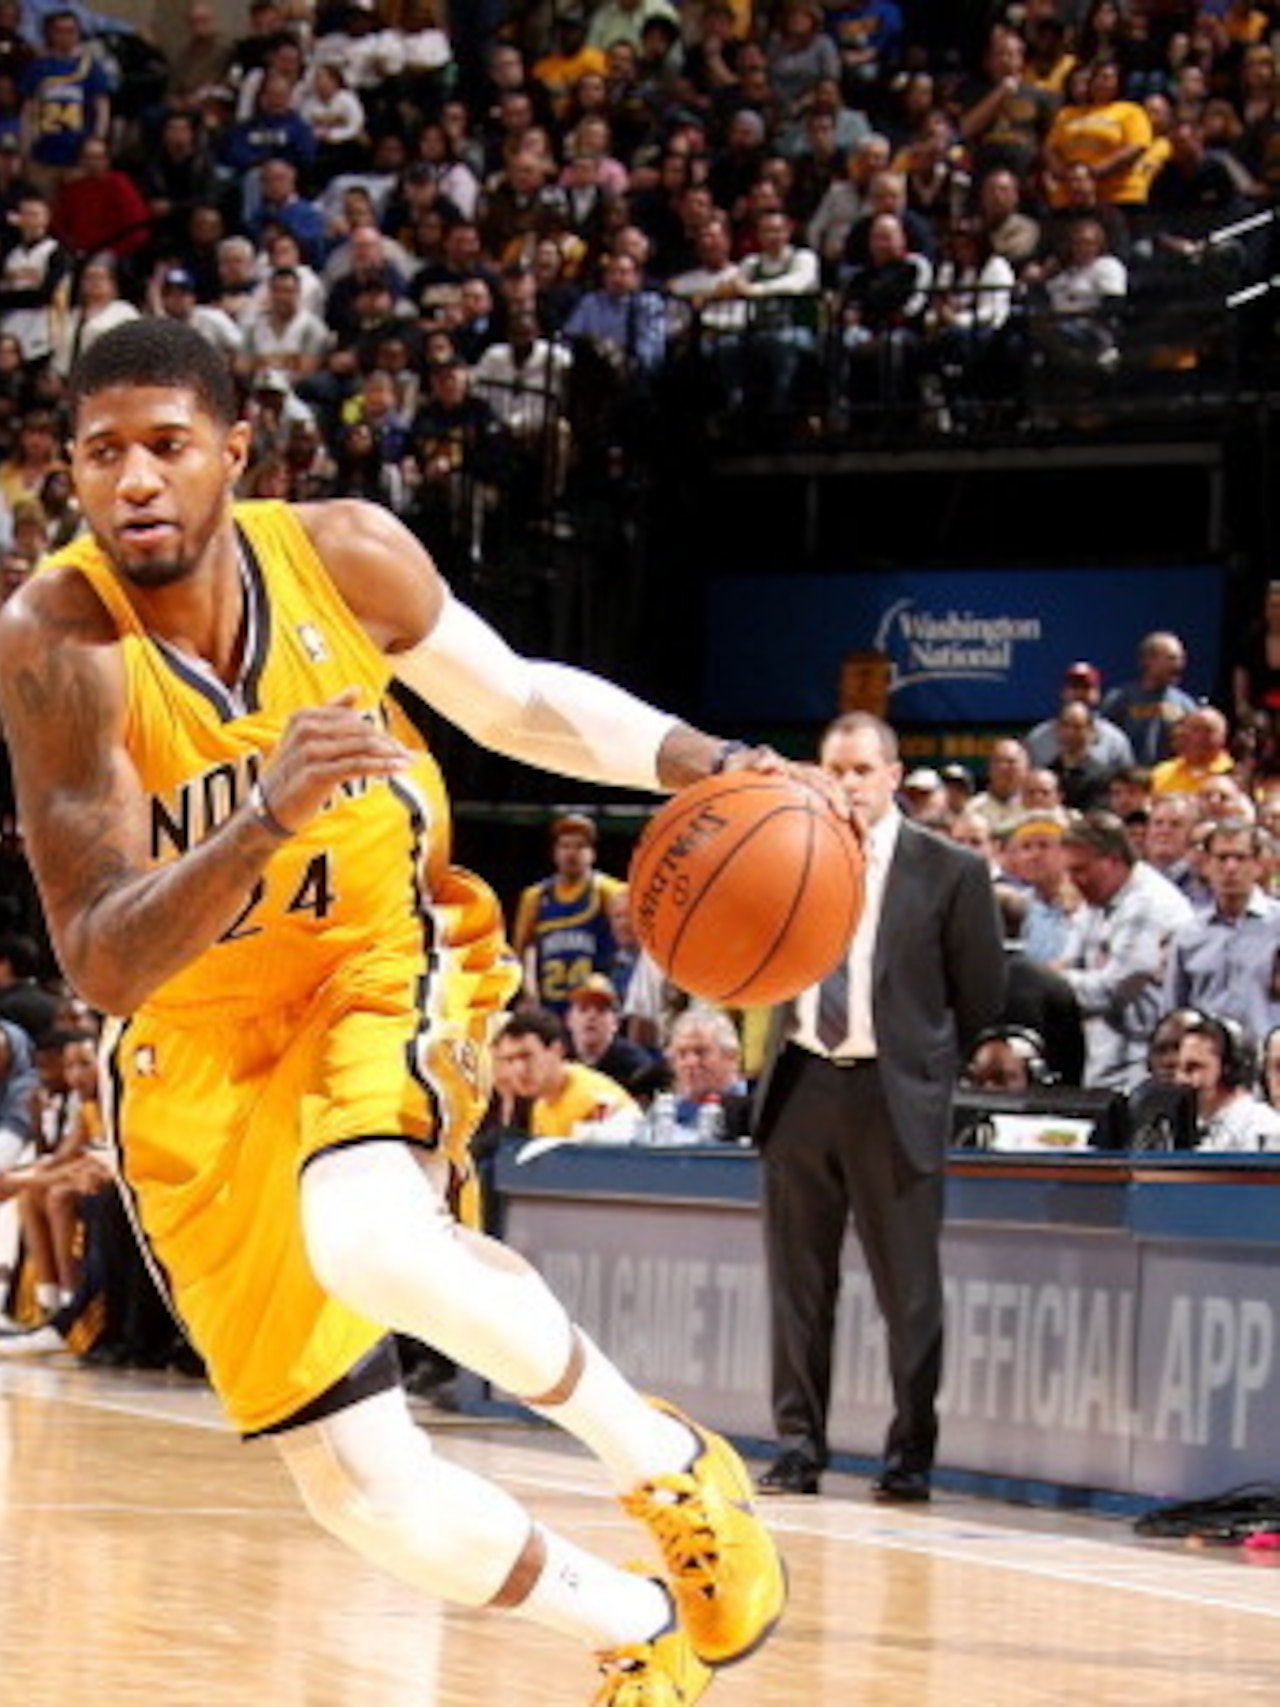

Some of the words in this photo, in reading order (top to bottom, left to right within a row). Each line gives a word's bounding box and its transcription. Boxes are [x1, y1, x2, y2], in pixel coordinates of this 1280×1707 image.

[897, 611, 1041, 646] Washington
[908, 640, 1011, 669] National
[608, 1255, 706, 1388] GAME
[714, 1260, 768, 1395] TIM
[1153, 1294, 1273, 1450] APP
